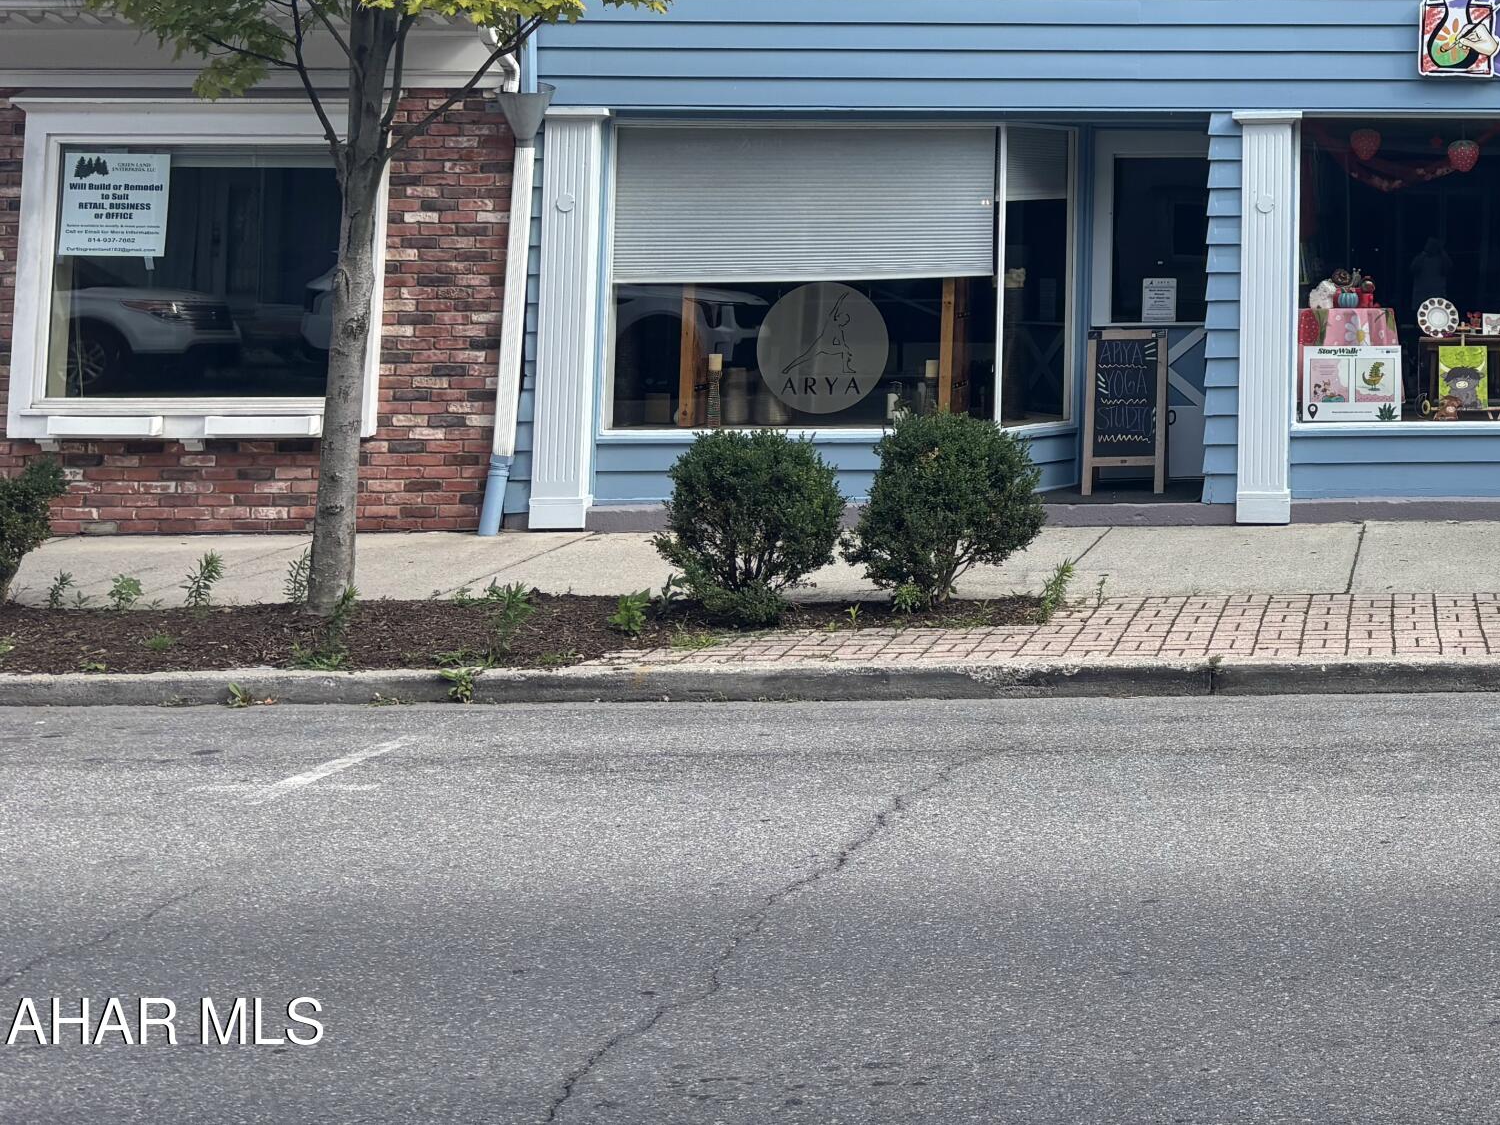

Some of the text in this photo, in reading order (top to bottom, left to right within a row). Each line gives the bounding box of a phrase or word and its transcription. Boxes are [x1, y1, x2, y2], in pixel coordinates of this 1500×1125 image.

[69, 182, 87, 191] Will
[88, 182, 111, 191] Build
[124, 183, 163, 192] Remodel
[78, 202, 151, 211] RETAIL, BUSINESS
[105, 212, 134, 220] OFFICE
[1099, 341, 1143, 365] ARYA
[781, 376, 860, 395] ARYA
[1104, 369, 1148, 398] YOGA
[1096, 405, 1153, 437] STUDIO
